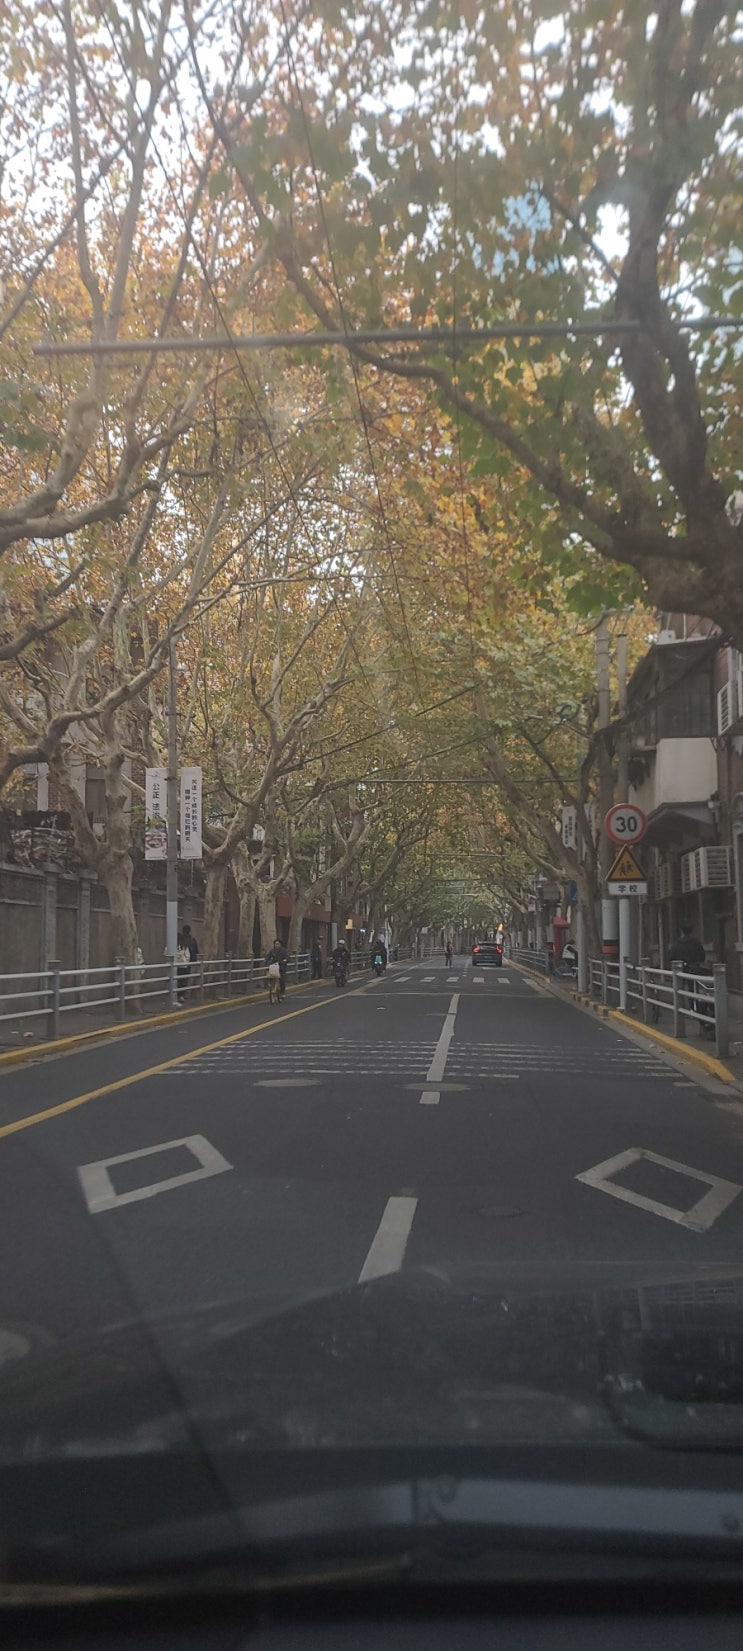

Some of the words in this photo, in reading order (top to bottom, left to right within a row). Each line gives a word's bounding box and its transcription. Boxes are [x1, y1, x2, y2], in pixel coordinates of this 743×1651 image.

[152, 783, 160, 799] 公正
[616, 816, 638, 832] 30
[618, 884, 638, 893] 学校
